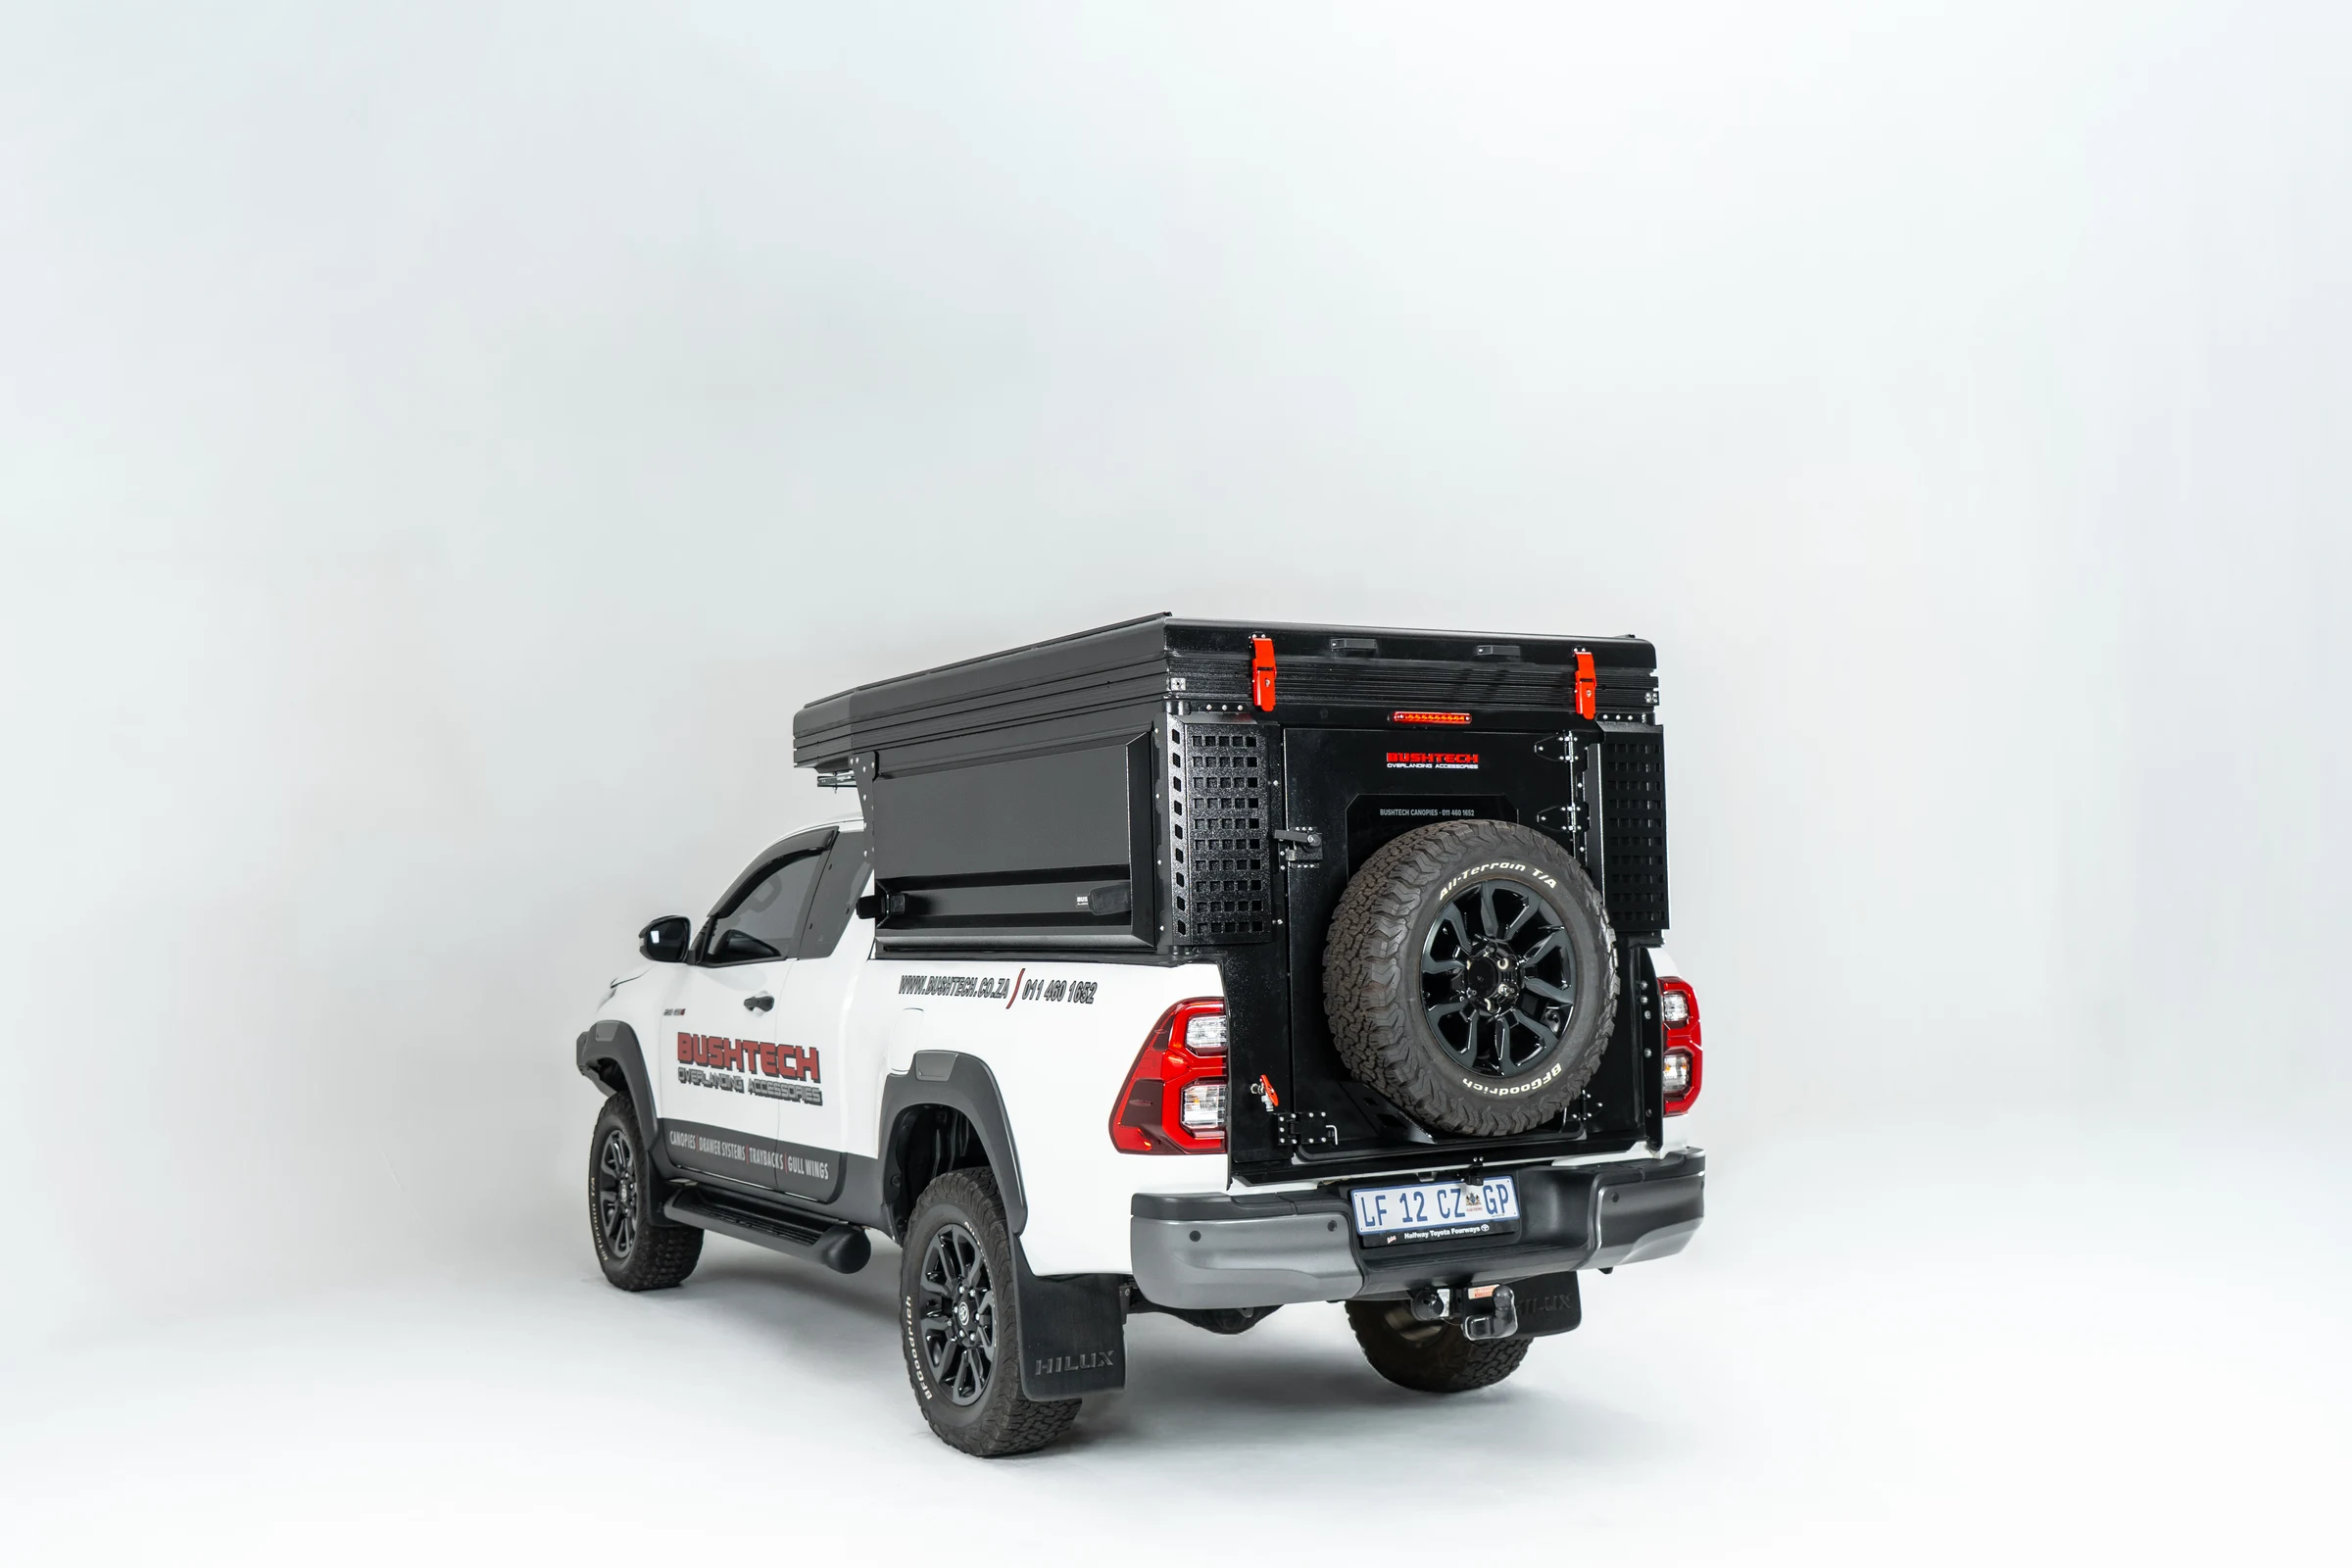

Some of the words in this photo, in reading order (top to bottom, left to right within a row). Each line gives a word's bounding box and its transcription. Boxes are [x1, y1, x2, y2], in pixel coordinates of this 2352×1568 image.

[1387, 752, 1479, 763] BUSHTECH
[1440, 861, 1526, 901] All-Terrain
[1532, 868, 1557, 889] T/A
[898, 975, 1010, 999] WWW.BUSHTECH.CO.ZA
[1021, 978, 1045, 1001] 011
[1044, 979, 1067, 1002] 460
[1067, 980, 1099, 1004] 1652
[677, 1031, 821, 1084] BUSHTECH
[677, 1066, 745, 1094] OVERLANDING
[748, 1078, 823, 1106] ACCESSORIES
[1462, 1062, 1562, 1097] BFGoodrich
[669, 1130, 696, 1150] CANOPIES
[699, 1136, 721, 1154] DRAWER
[721, 1142, 746, 1161] SYSTEMS
[749, 1148, 784, 1170] TRAYBACKS
[787, 1155, 805, 1174] GULL
[805, 1159, 829, 1180] WINGS
[1360, 1195, 1388, 1227] LF
[1399, 1191, 1428, 1223] 12
[1437, 1188, 1466, 1219] CZ
[1483, 1184, 1509, 1215] GP
[1404, 1231, 1430, 1241] Halfway
[1430, 1229, 1451, 1238] Toyota
[1451, 1226, 1481, 1235] Fourways
[906, 1296, 933, 1400] BFGoodrich
[1035, 1350, 1114, 1376] HILUX
